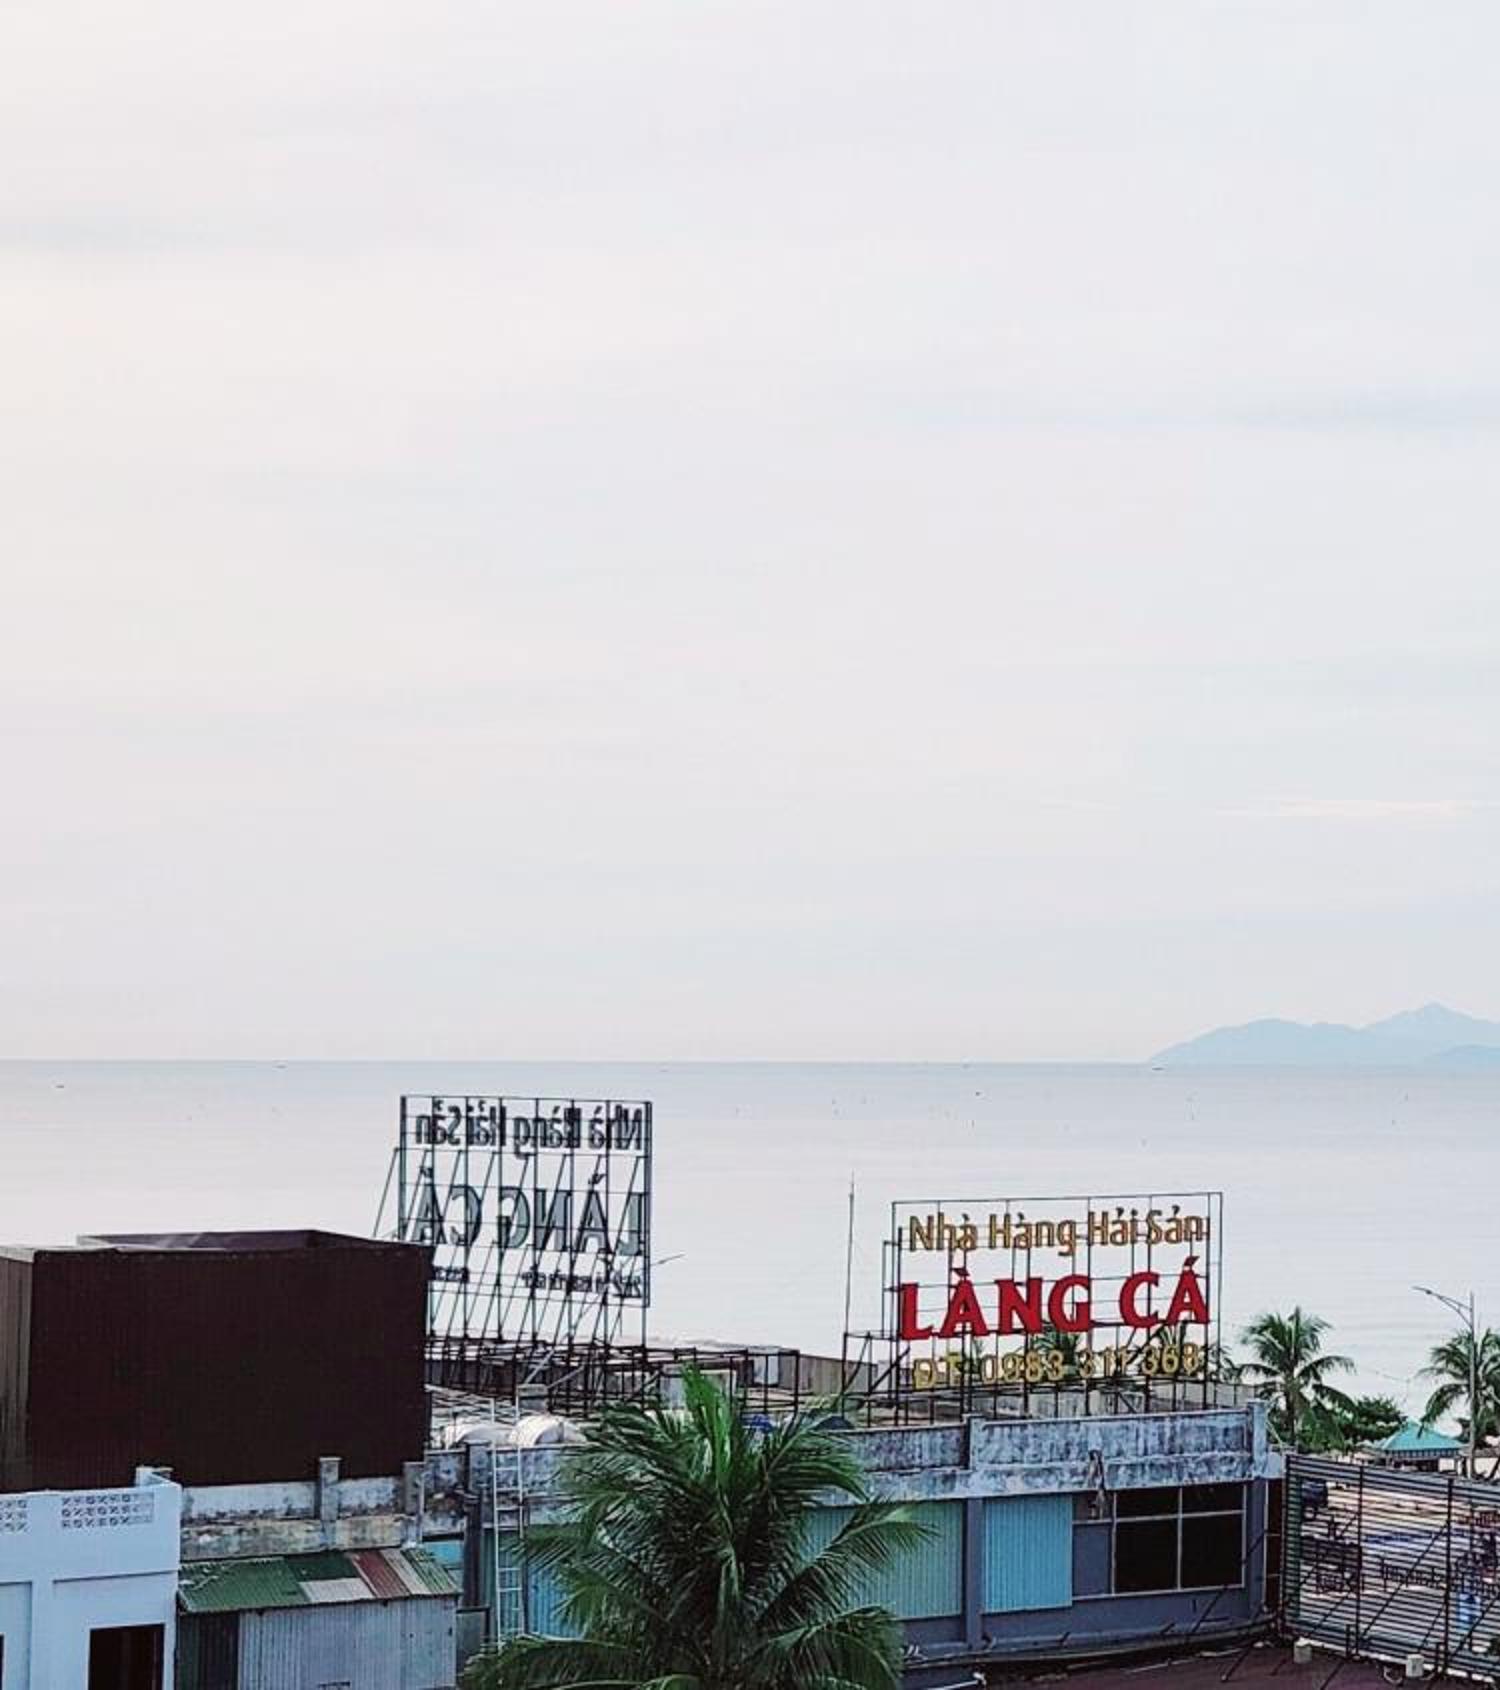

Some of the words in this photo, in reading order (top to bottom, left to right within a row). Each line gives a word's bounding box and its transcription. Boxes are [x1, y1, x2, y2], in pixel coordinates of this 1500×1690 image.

[909, 1211, 977, 1252] Nhà
[989, 1213, 1076, 1256] Hàng
[1088, 1208, 1138, 1247] Hải
[1147, 1205, 1206, 1244] Sản
[900, 1267, 1091, 1341] LÀNG
[1119, 1256, 1211, 1329] CÁ
